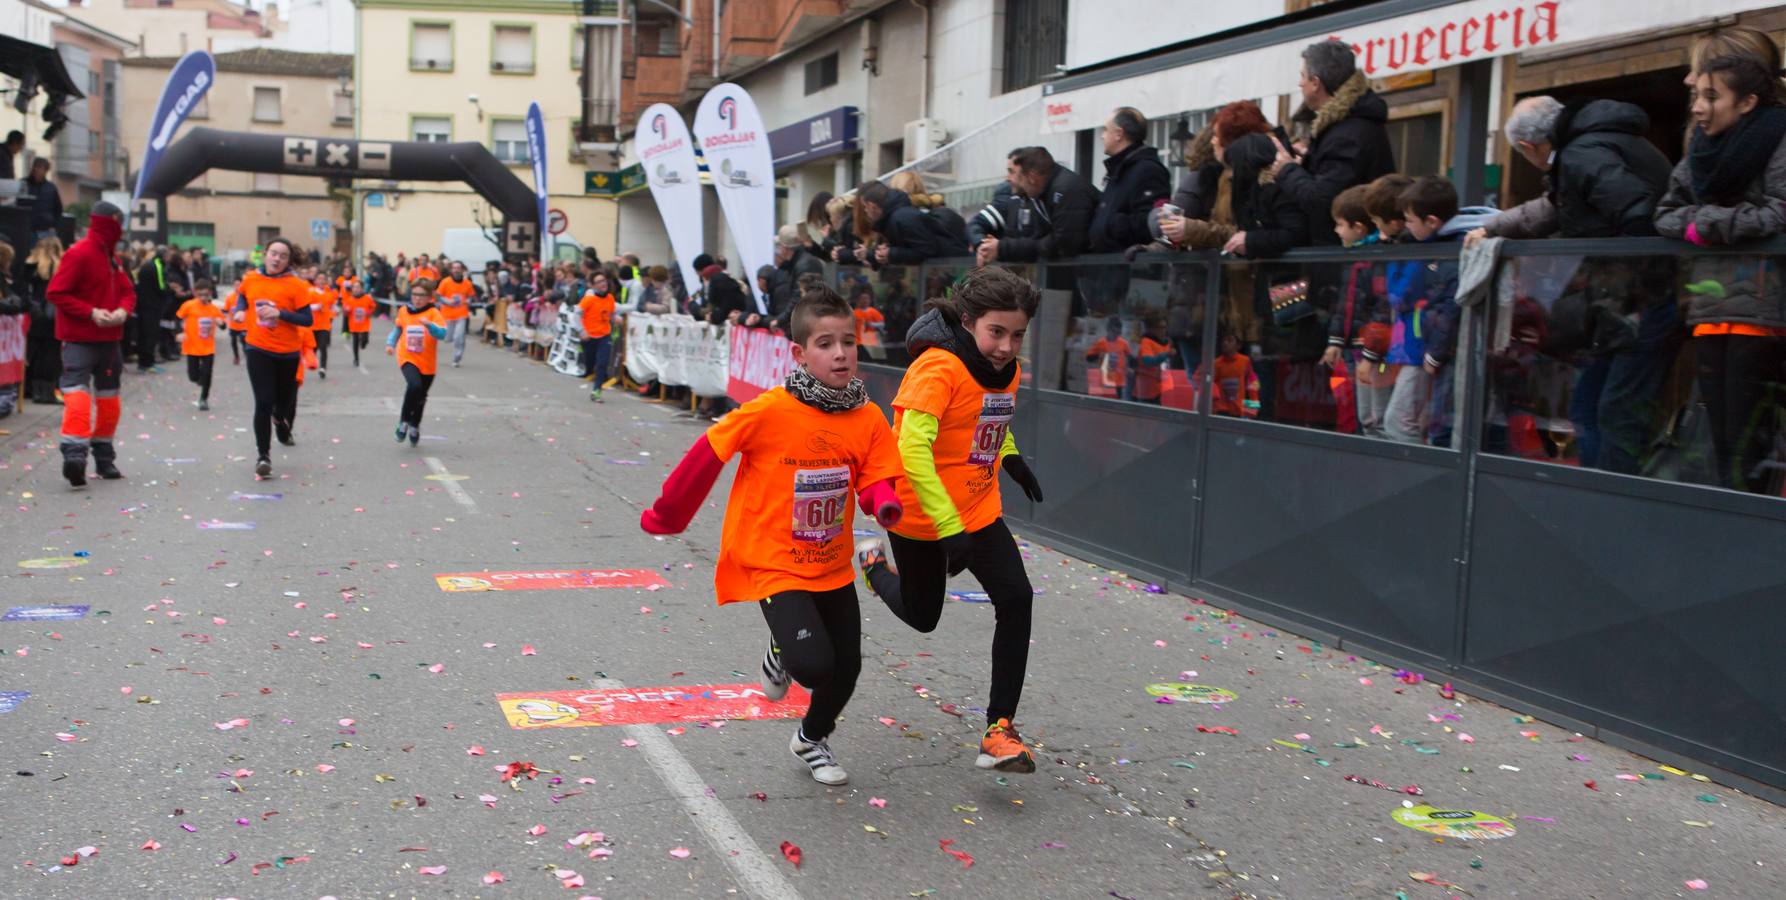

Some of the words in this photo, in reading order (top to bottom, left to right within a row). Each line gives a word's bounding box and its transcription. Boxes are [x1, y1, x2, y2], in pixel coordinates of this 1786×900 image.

[1328, 1, 1561, 76] rveceria
[799, 458, 830, 467] SILVESTRE
[807, 470, 849, 479] AYUNTAMIENTO
[807, 497, 837, 528] 60
[790, 543, 844, 556] AYUNTAMIENTO
[794, 556, 804, 564] DE
[807, 552, 839, 564] LARDERO
